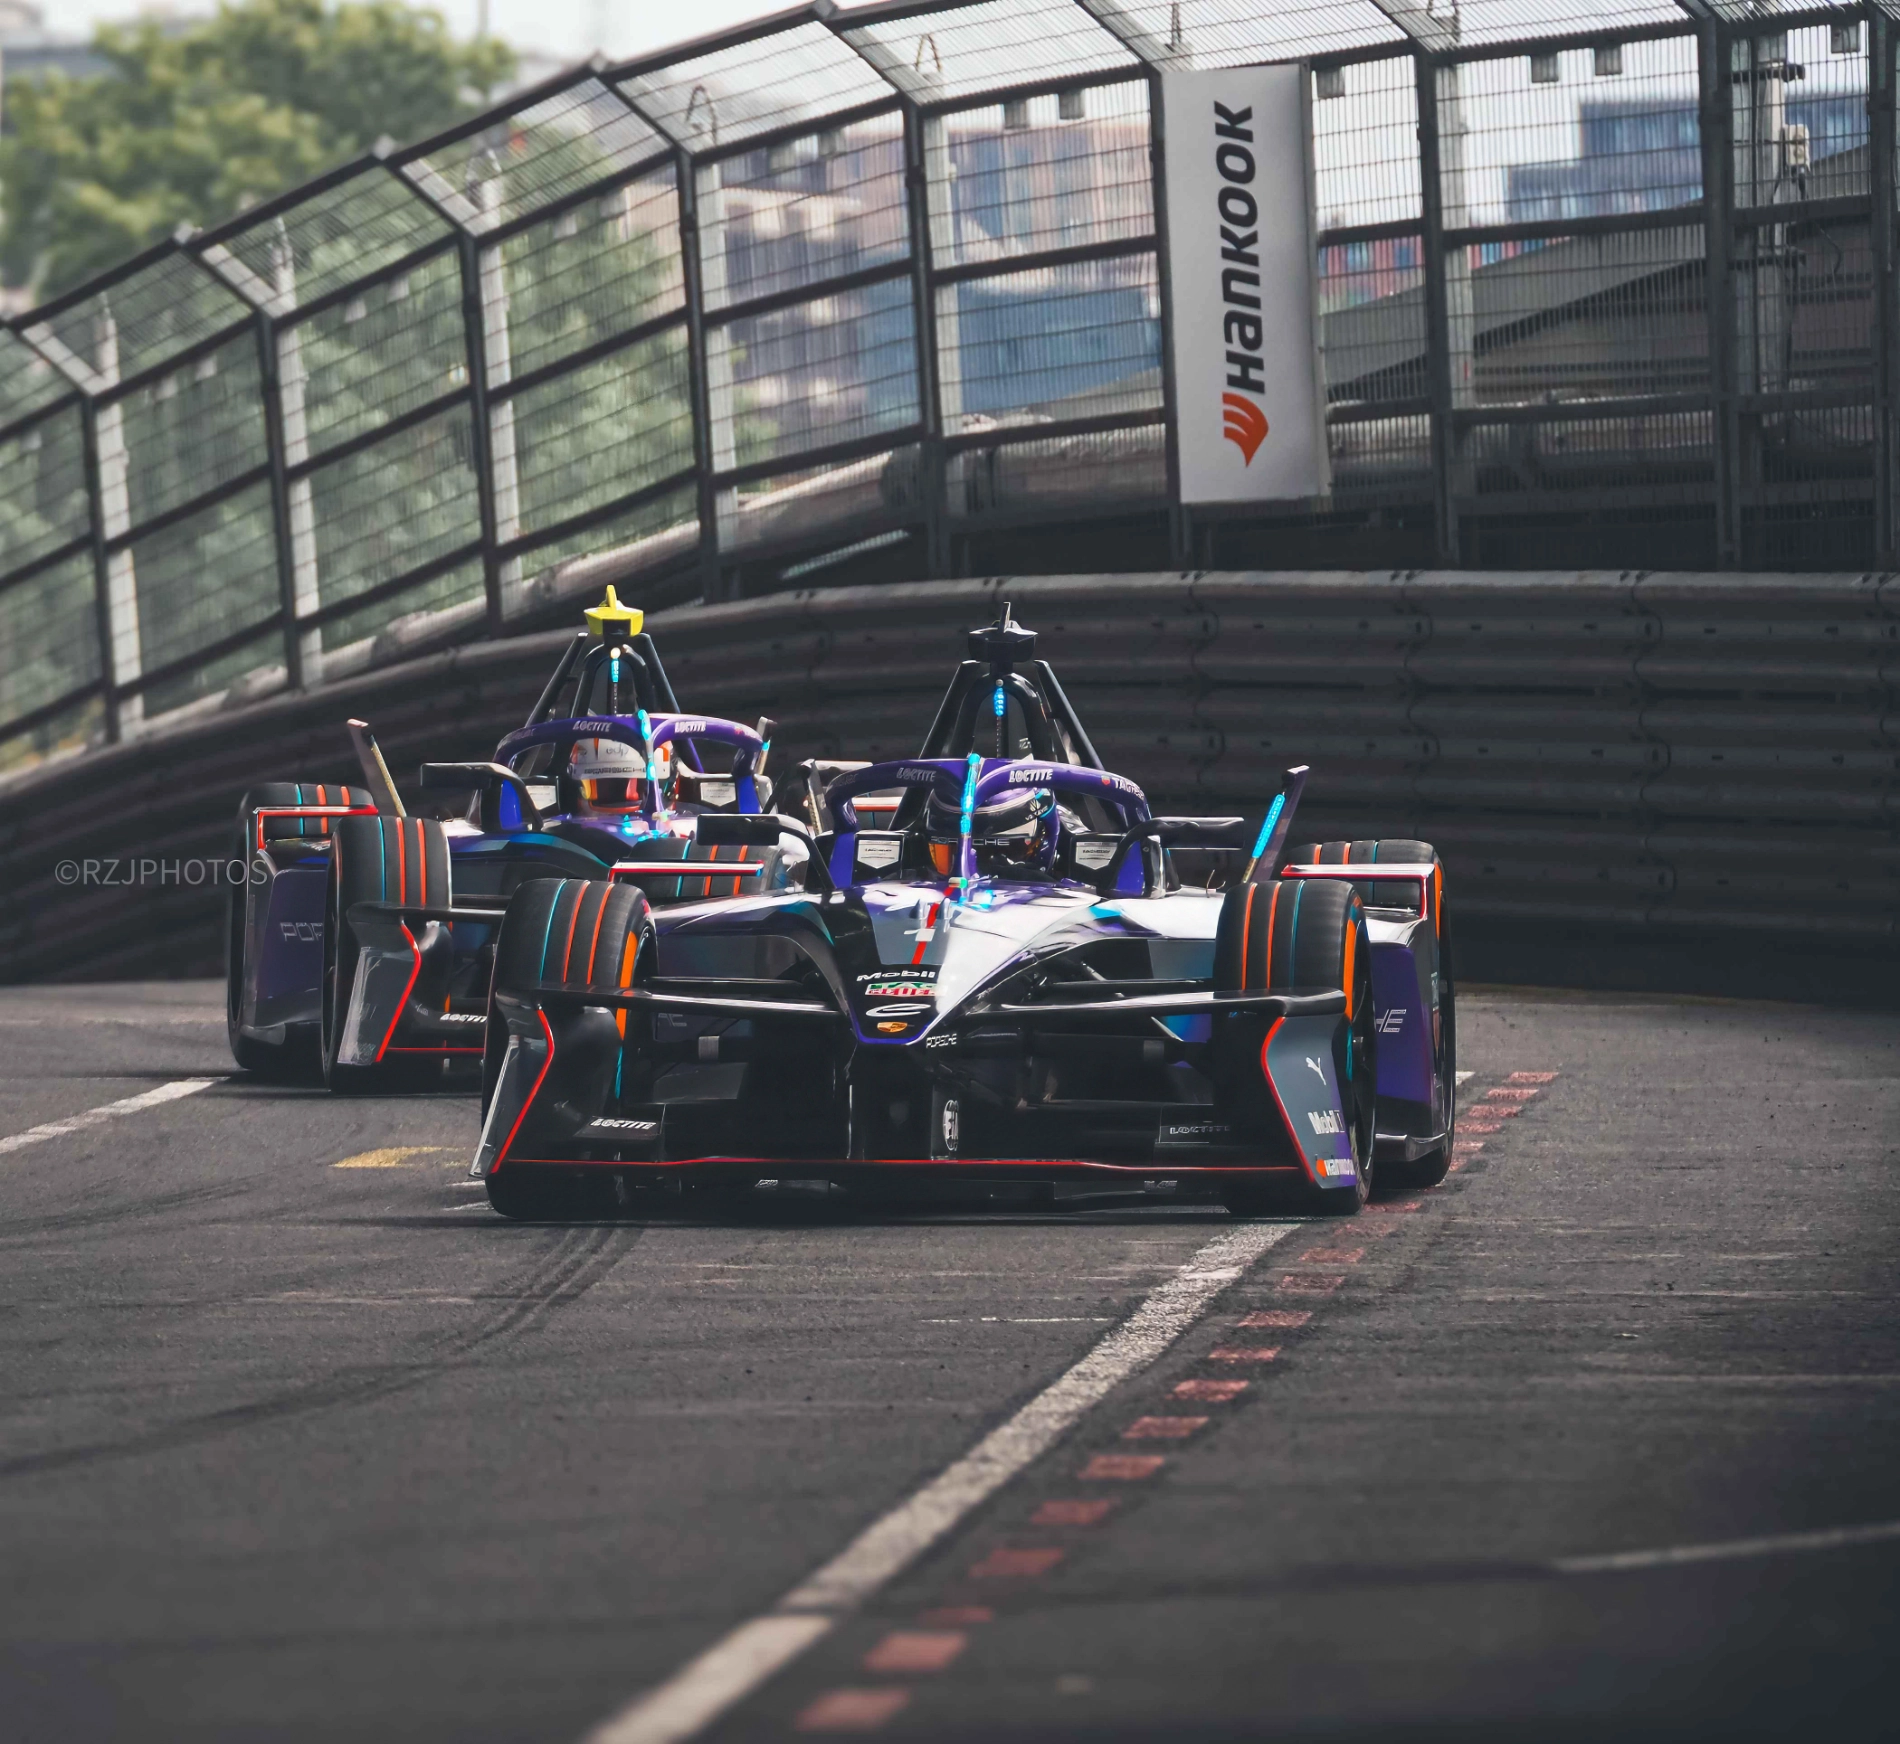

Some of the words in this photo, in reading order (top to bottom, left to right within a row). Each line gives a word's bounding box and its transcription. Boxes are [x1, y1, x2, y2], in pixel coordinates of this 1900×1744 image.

[572, 720, 613, 733] LOCTITE
[674, 720, 707, 733] LOCTITE
[896, 767, 937, 782] LOCTITE
[1008, 769, 1054, 784] LOCTITE
[931, 835, 1010, 846] PORCHE
[440, 1013, 488, 1022] LOCTIT
[590, 1118, 657, 1130] LOCTITE
[1307, 1109, 1339, 1134] Mobil
